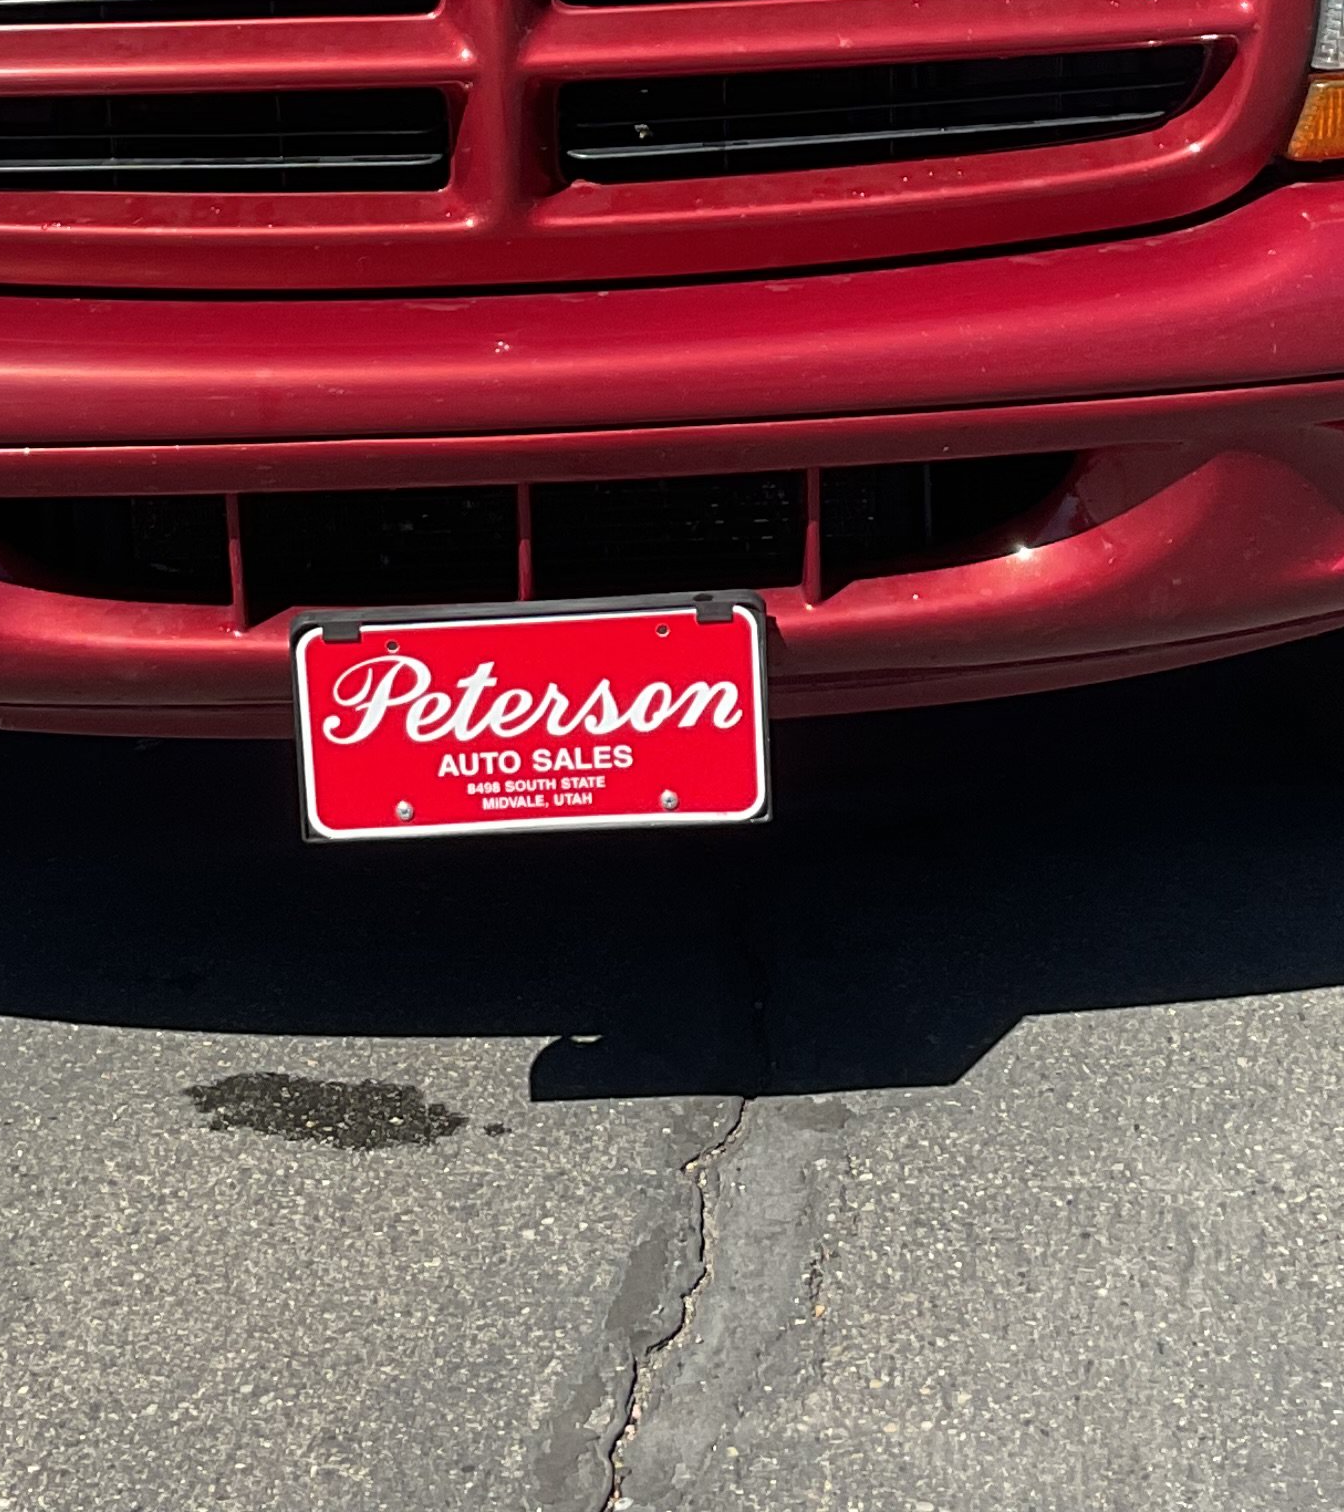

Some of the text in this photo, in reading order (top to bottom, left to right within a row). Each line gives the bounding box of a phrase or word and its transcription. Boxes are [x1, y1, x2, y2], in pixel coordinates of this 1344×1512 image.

[322, 654, 743, 745] Peterson
[437, 744, 634, 778] AUTO SALES
[467, 775, 606, 795] 8498 SOUTH STATE
[482, 791, 593, 810] MIDVALE, UTAH
